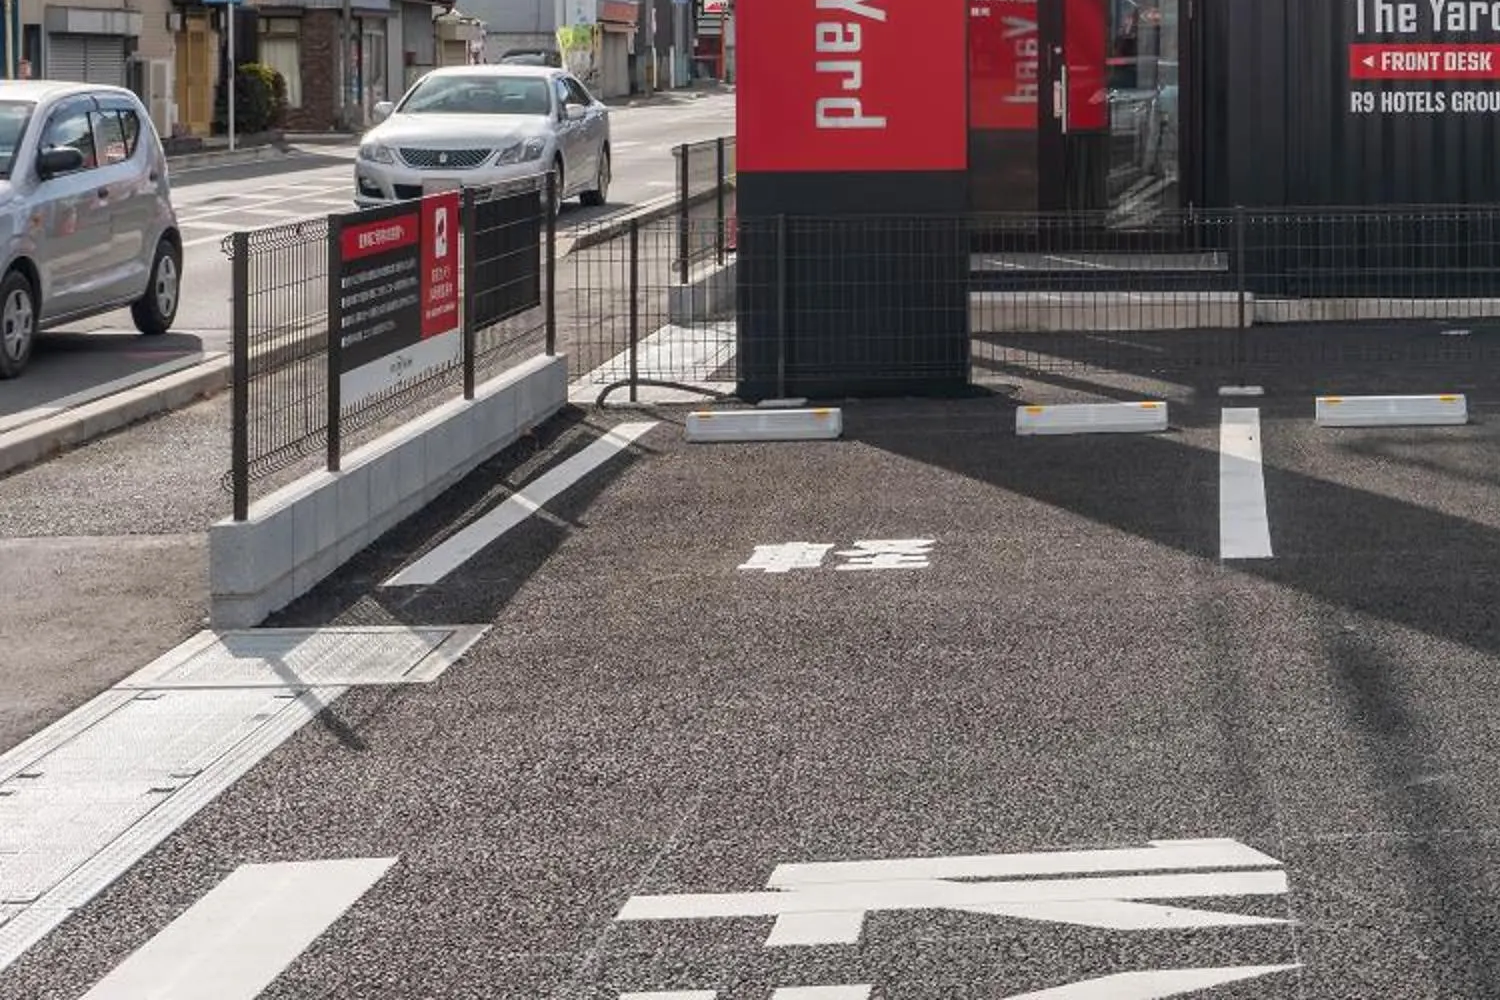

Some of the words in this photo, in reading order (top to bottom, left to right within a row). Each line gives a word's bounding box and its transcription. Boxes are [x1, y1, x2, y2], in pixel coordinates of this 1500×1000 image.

[1381, 51, 1441, 71] FRONT
[1444, 51, 1492, 71] DESK
[1351, 91, 1375, 113] R9
[1381, 91, 1446, 113] HOTELS
